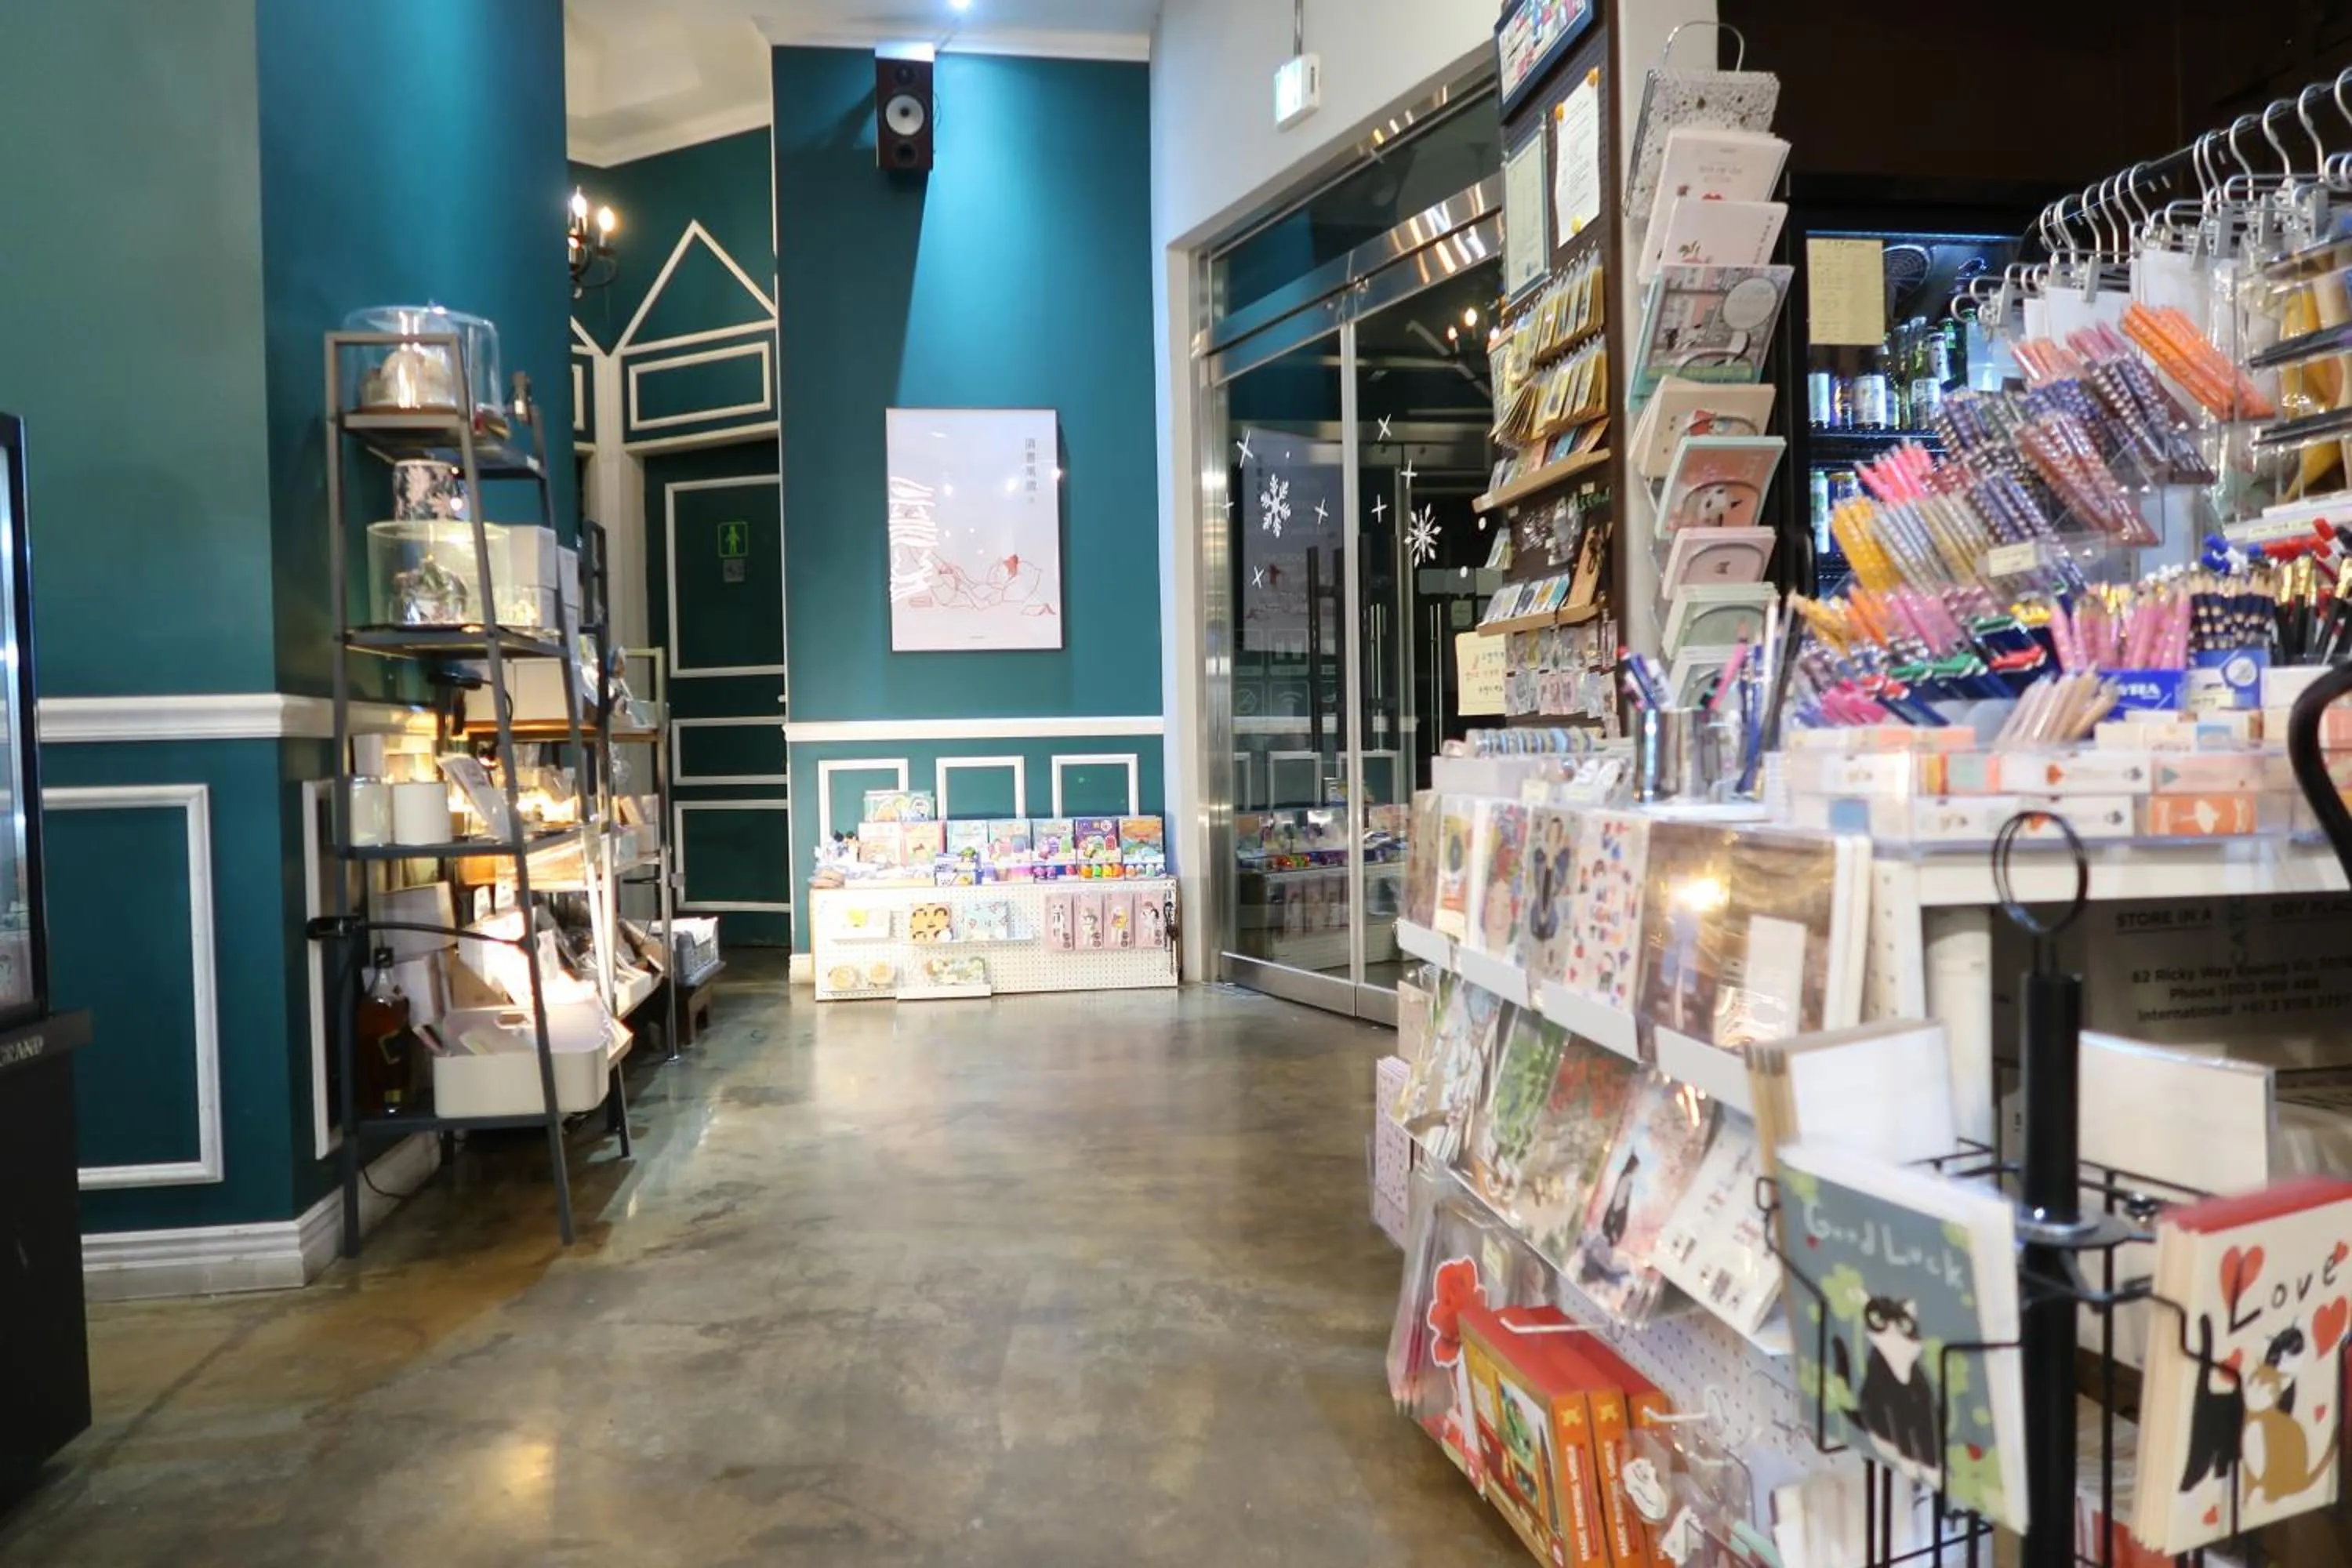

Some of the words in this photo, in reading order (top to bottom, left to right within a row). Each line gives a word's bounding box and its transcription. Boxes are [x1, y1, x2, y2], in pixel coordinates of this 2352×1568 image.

[2115, 909, 2172, 927] STORE
[2169, 986, 2215, 1000] Phone
[2137, 1005, 2233, 1022] International
[1804, 1199, 1877, 1256] Good
[1882, 1223, 1964, 1287] Luck
[2228, 1248, 2337, 1334] Love
